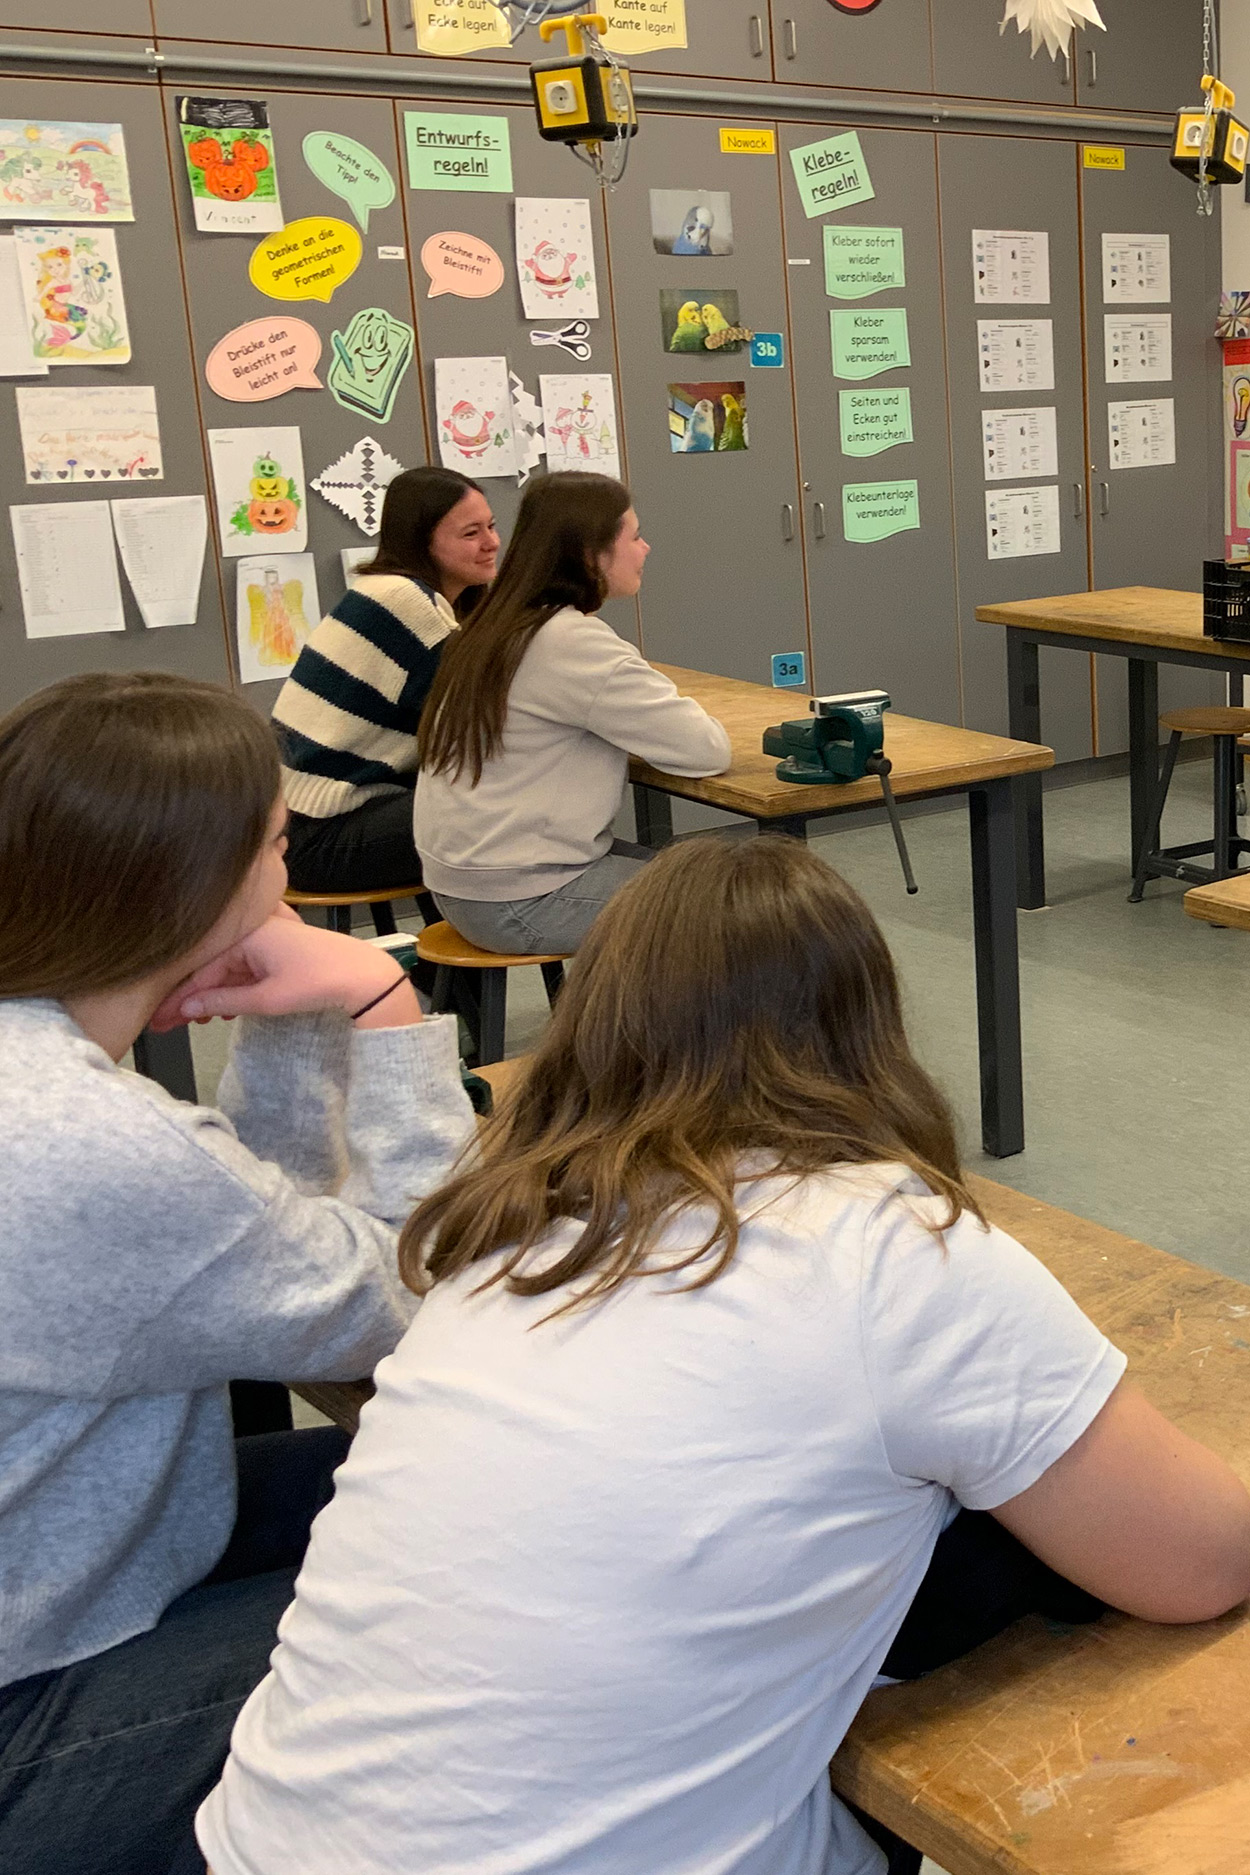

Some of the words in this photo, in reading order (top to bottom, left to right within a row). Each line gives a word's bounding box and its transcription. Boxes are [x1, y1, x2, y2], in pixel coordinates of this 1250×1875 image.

[614, 0, 646, 11] Kante
[649, 2, 668, 14] auf
[428, 14, 459, 28] Ecke
[463, 17, 496, 34] legen!
[608, 16, 641, 31] Kante
[645, 20, 676, 36] legen!
[416, 127, 500, 148] Entwurfs-
[727, 136, 768, 149] Nowack
[325, 140, 361, 170] Beachte
[363, 168, 380, 183] den
[434, 157, 489, 177] regeln!
[803, 150, 851, 173] Klebe-
[1089, 153, 1119, 165] Nowack
[337, 164, 358, 184] Tipp!
[811, 170, 860, 199] regeln!
[266, 243, 300, 261] Denke
[303, 236, 316, 247] an
[318, 229, 335, 240] die
[832, 236, 862, 247] Kleber
[865, 237, 895, 248] sofort
[438, 240, 474, 259] Zeichne
[476, 255, 492, 265] mit
[848, 254, 880, 265] wieder
[271, 243, 345, 281] geometrischen
[443, 256, 483, 276] Bleistift!
[294, 264, 335, 288] Formen!
[836, 271, 895, 283] verschließen!
[854, 316, 884, 328] Kleber
[227, 341, 265, 361] Drücke
[268, 331, 288, 343] den
[851, 334, 889, 346] sparsam
[757, 343, 777, 357] 3b
[845, 353, 898, 363] verwenden!
[232, 353, 277, 378] Bleistift
[280, 345, 297, 358] nur
[248, 371, 279, 391] leicht
[283, 361, 299, 376] an!
[851, 397, 879, 408] Seiten
[882, 396, 899, 406] und
[853, 413, 880, 425] Ecken
[883, 413, 898, 427] gut
[847, 430, 906, 442] einstreichen!
[847, 488, 915, 503] Klebeunterlage
[856, 505, 907, 519] verwenden!
[779, 663, 798, 676] 3a
